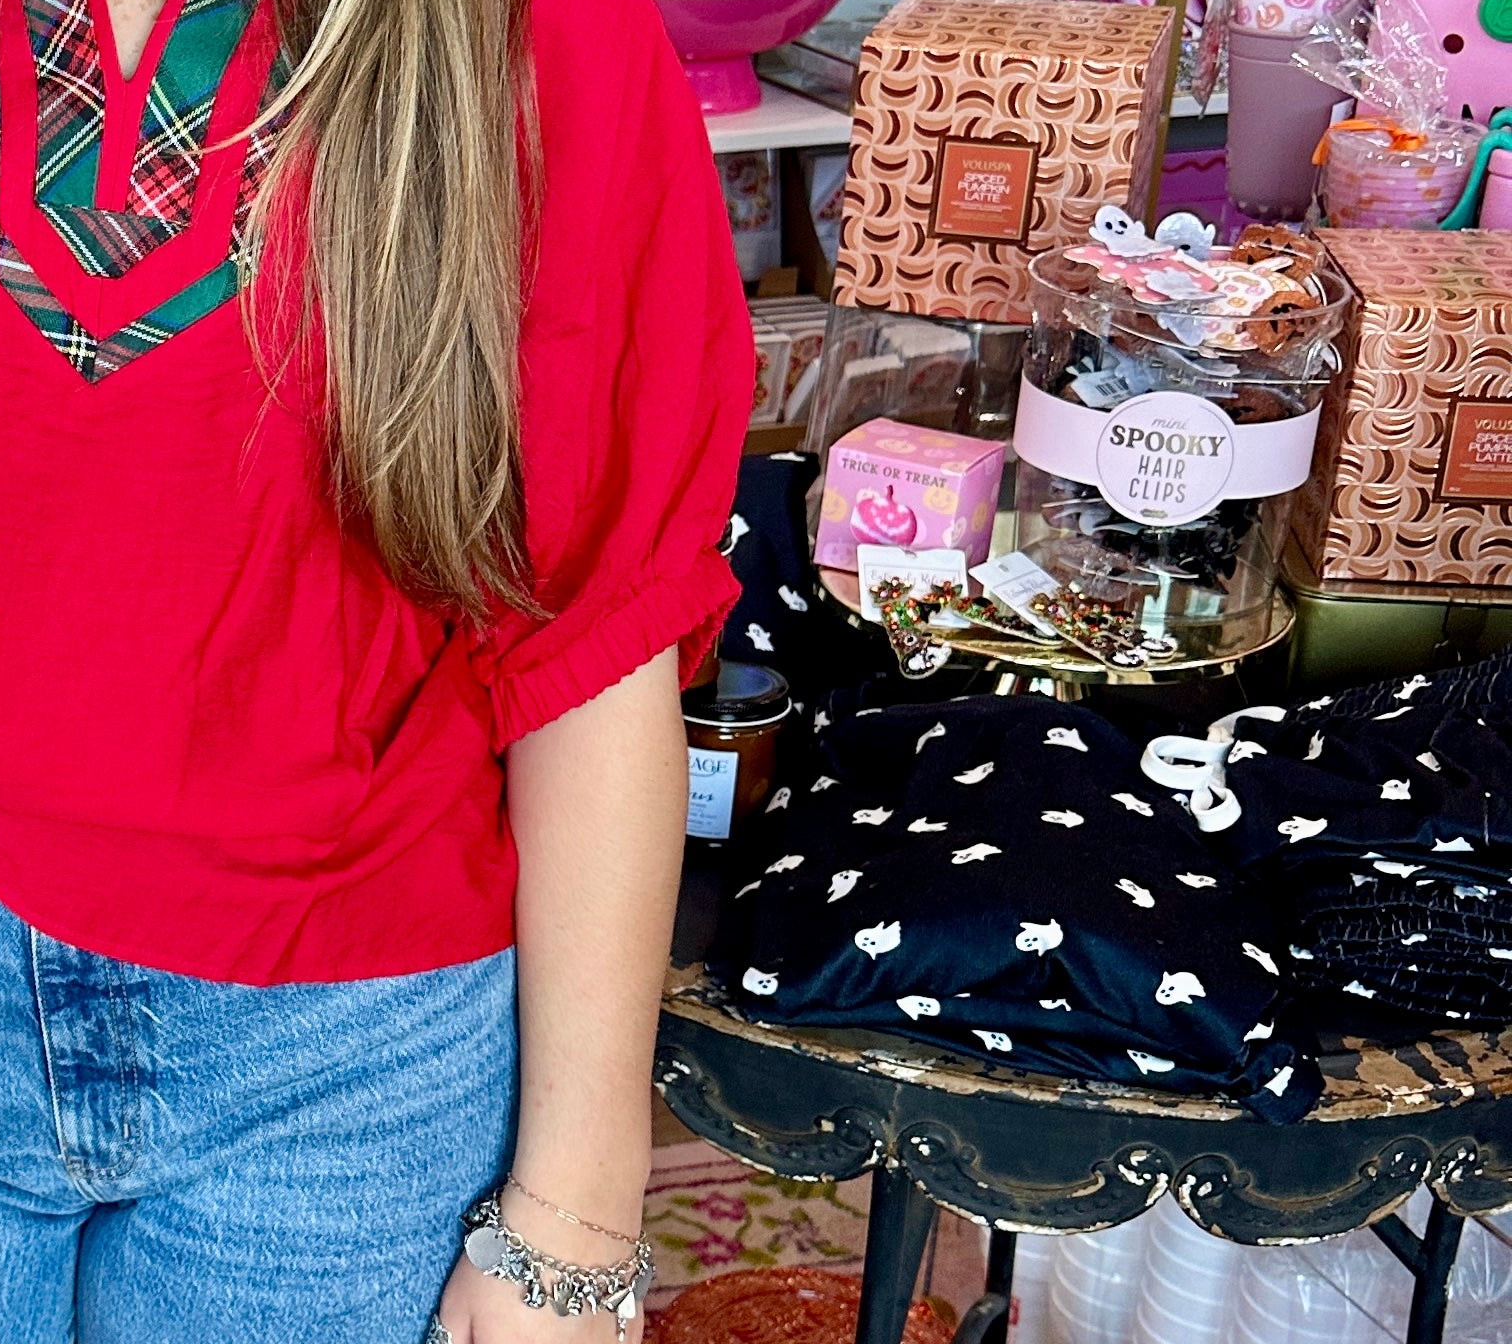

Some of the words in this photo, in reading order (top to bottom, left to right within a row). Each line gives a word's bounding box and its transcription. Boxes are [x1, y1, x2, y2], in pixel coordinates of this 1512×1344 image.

[962, 159, 1012, 172] VOLUSPA
[963, 172, 1006, 185] SPICED
[958, 181, 1010, 195] PUMPKIN
[964, 191, 1001, 203] LATTE
[1151, 417, 1188, 430] mini
[1109, 424, 1226, 457] SPOOKY
[841, 457, 879, 475] TRICK
[883, 466, 900, 479] OR
[905, 470, 947, 489] TREAT
[1137, 454, 1186, 480] HAIR
[1128, 477, 1186, 504] CLIPS
